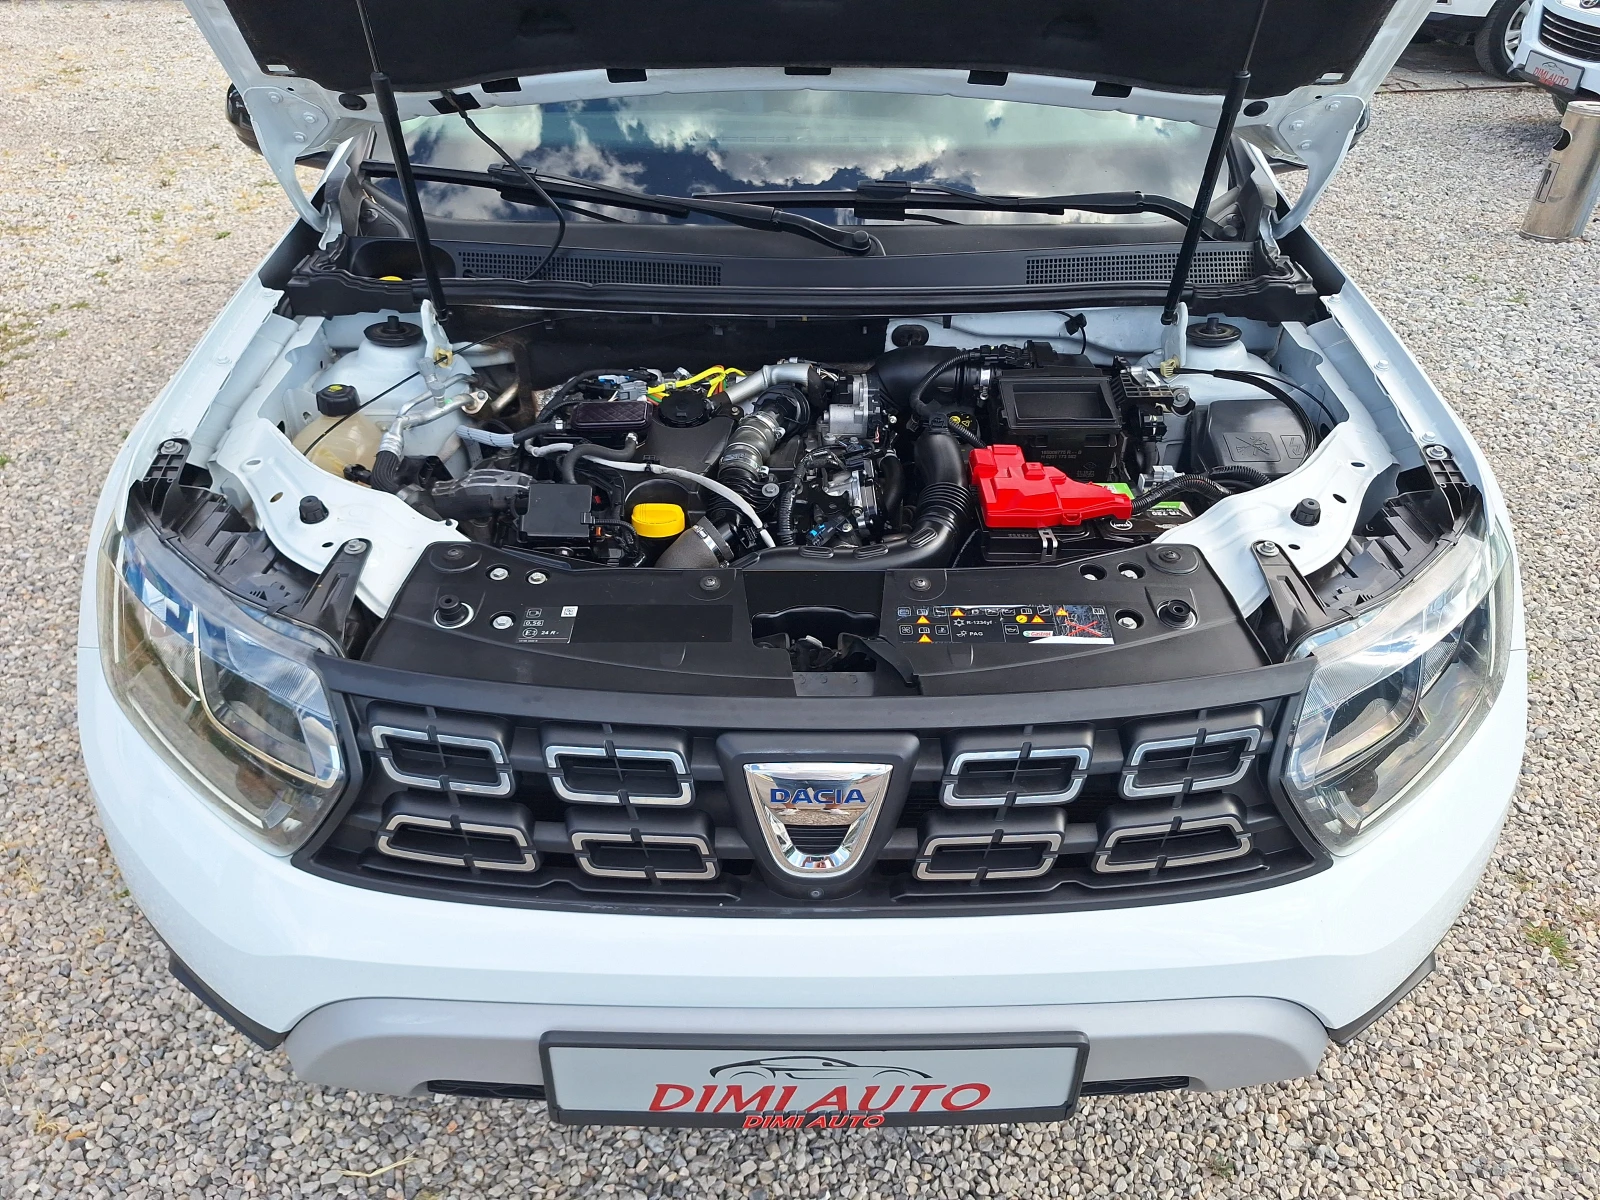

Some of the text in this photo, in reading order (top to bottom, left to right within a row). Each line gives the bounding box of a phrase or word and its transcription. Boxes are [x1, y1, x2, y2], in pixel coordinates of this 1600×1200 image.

[1533, 67, 1548, 79] DIMI
[1549, 73, 1569, 87] AUTO
[770, 788, 866, 804] DACIA
[649, 1082, 991, 1113] DIMI AUTO
[742, 1114, 885, 1128] DIMI AUTO
